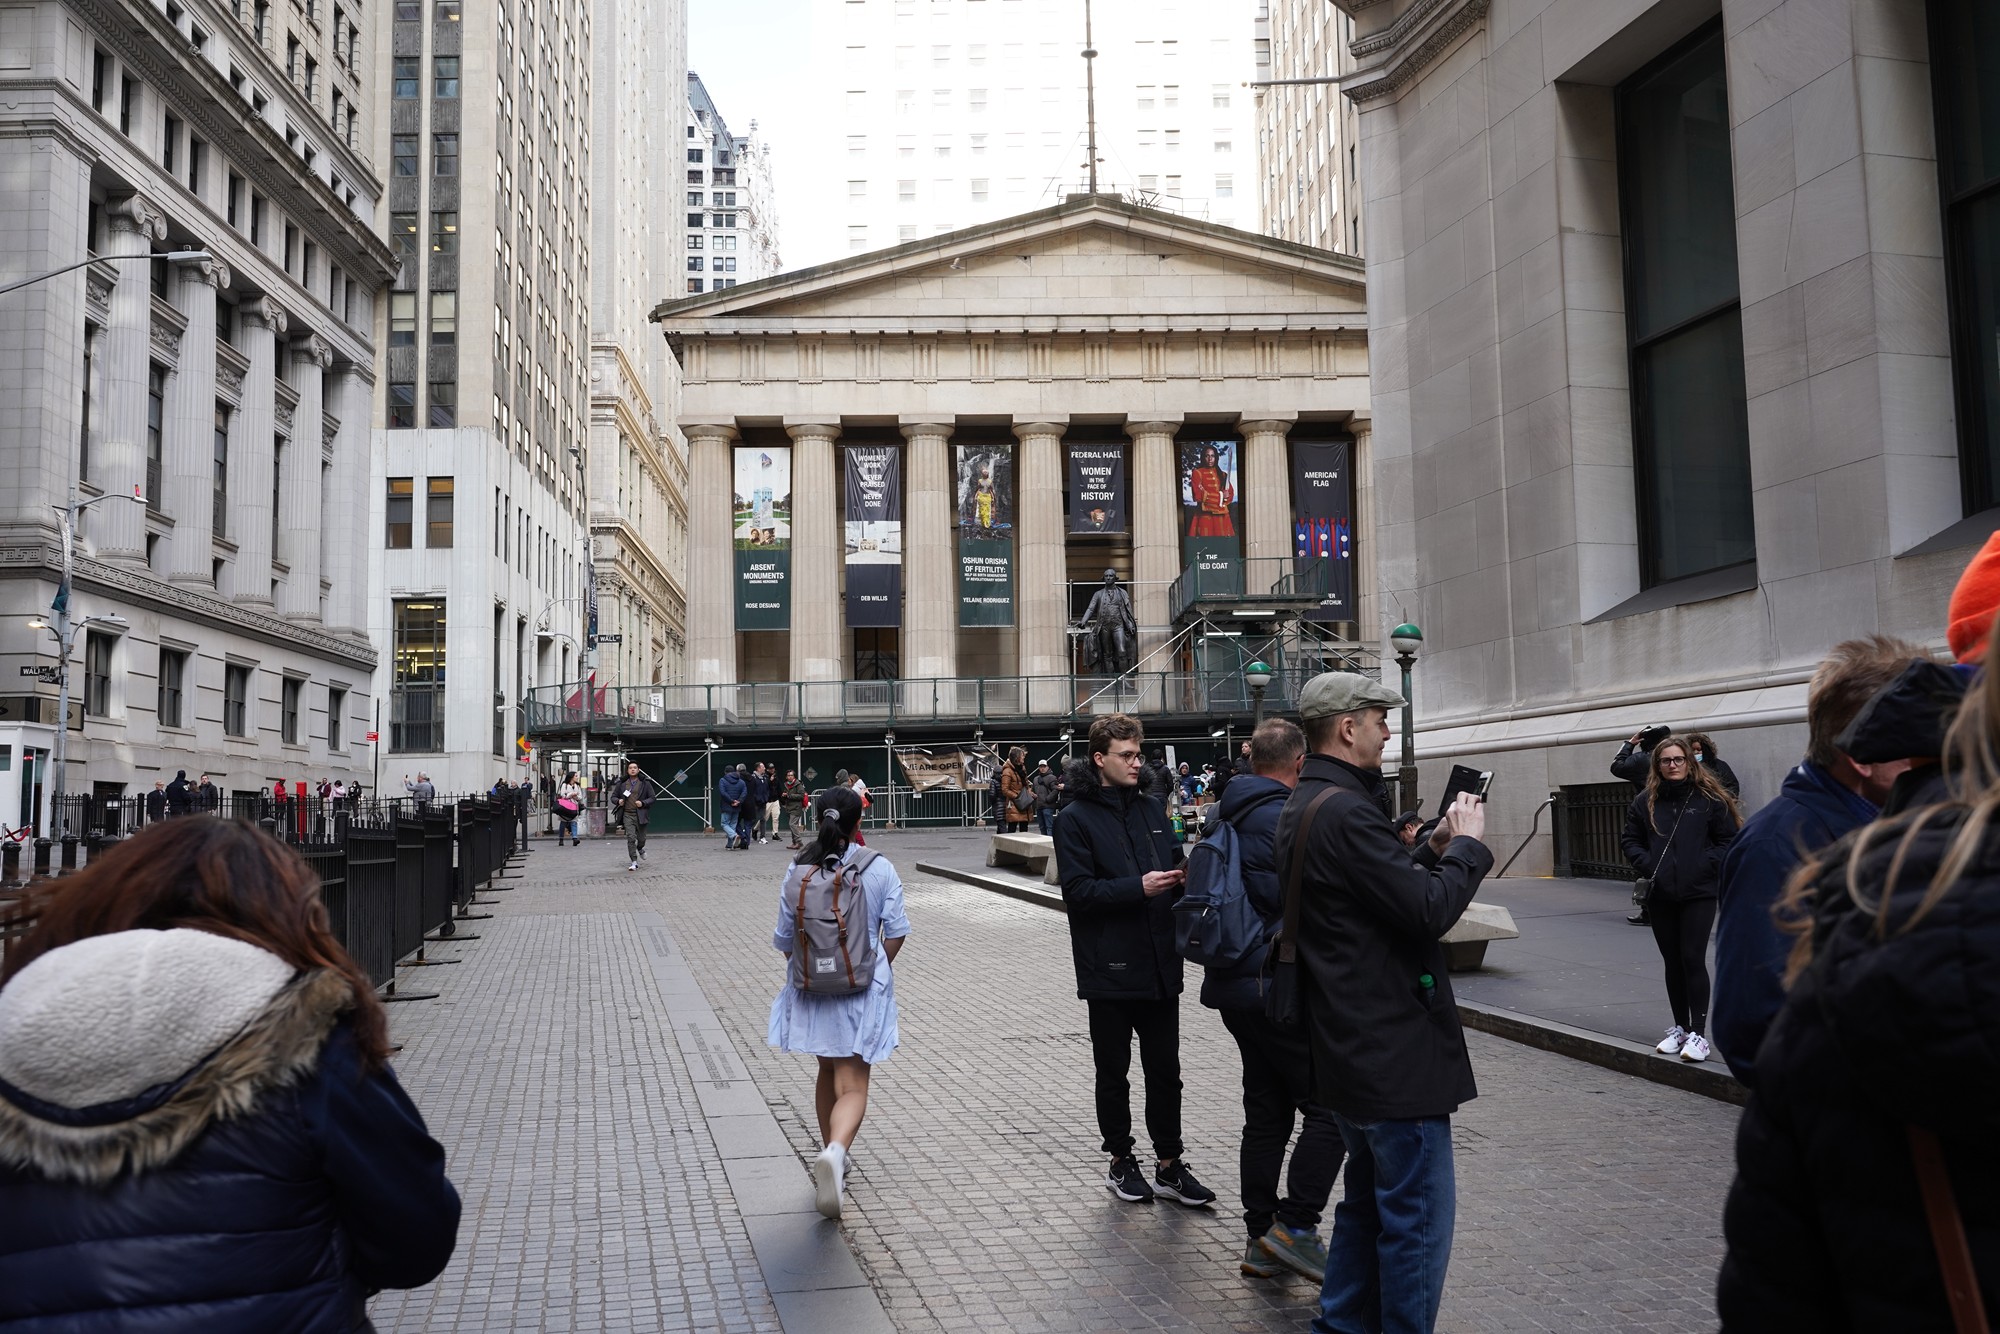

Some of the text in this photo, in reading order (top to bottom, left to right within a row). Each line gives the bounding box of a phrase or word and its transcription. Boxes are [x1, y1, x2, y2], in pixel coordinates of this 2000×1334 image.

[1080, 467, 1112, 476] WOMEN
[1081, 492, 1114, 500] HISTORY
[938, 762, 965, 770] OPEN!
